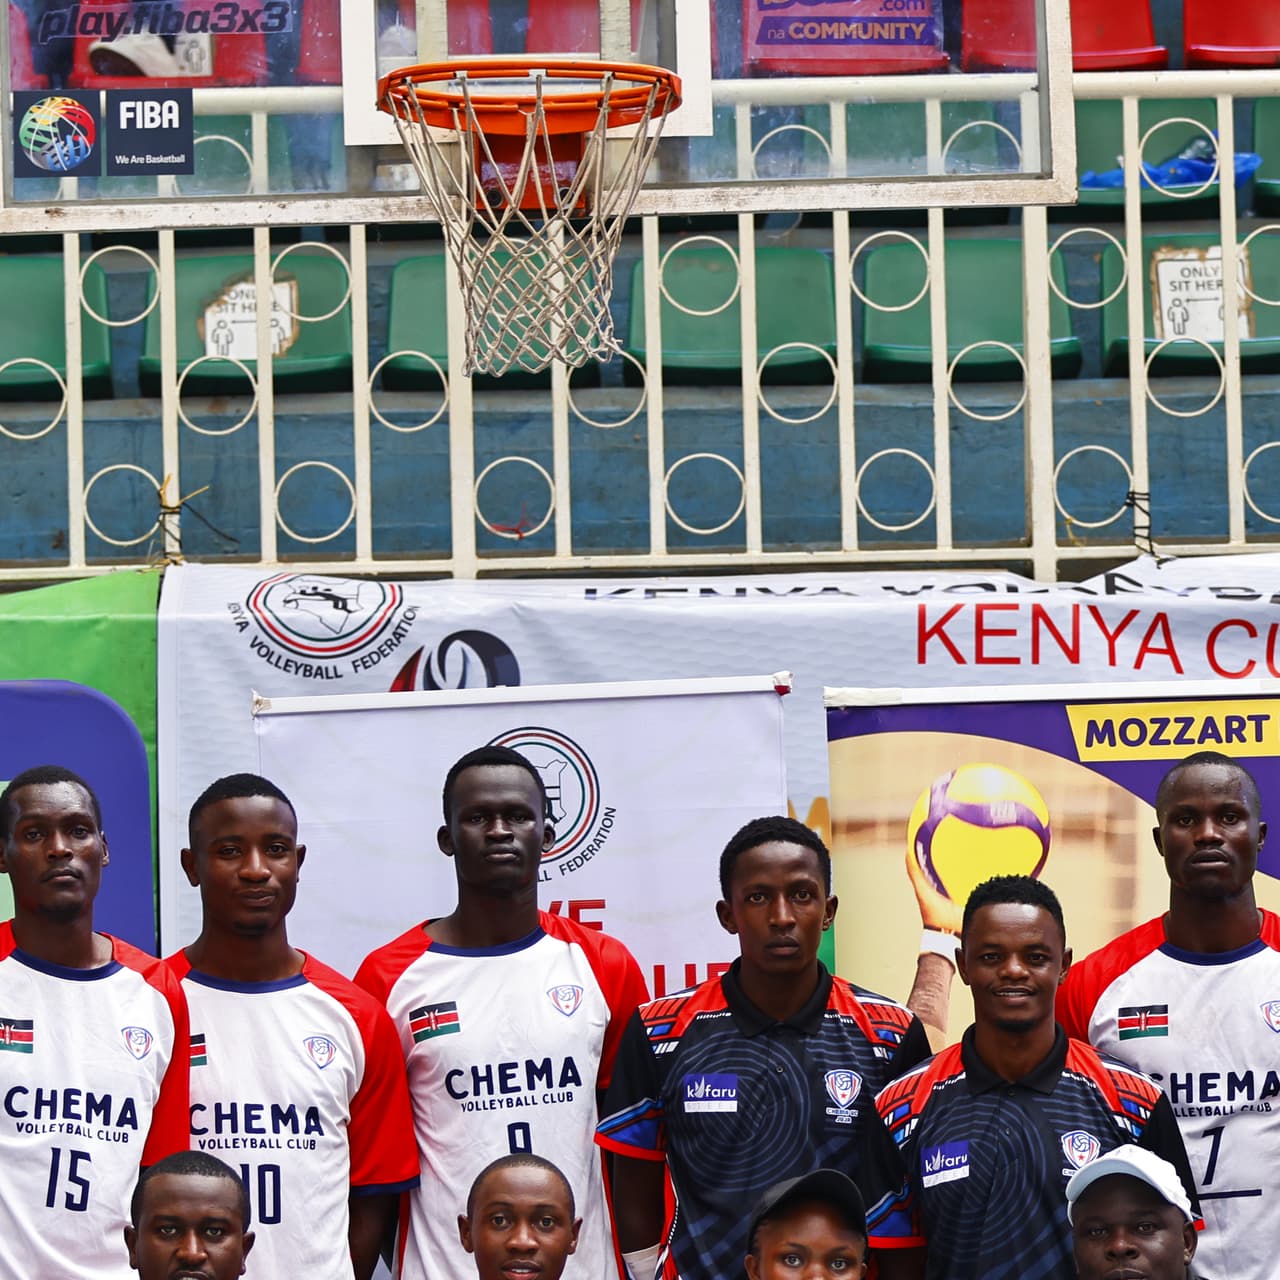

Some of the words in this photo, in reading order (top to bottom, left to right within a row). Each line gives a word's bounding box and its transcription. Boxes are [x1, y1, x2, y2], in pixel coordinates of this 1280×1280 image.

[767, 28, 786, 40] na
[788, 22, 927, 41] COMMUNITY
[119, 100, 180, 129] FIBA
[115, 155, 129, 165] We
[130, 155, 145, 165] Are
[146, 154, 186, 165] Basketball
[1170, 280, 1191, 291] SIT
[1196, 280, 1224, 291] HER
[1180, 266, 1220, 279] ONLY
[249, 635, 344, 680] VOLLEYBALL
[351, 604, 420, 674] FEDERATION
[917, 603, 1185, 675] KENYA
[1083, 713, 1273, 749] MOZZART
[558, 806, 617, 876] FEDERATION
[445, 1056, 582, 1100] CHEMA
[4, 1085, 139, 1131] CHEMA
[461, 1094, 539, 1112] VOLLEYBALL
[541, 1090, 574, 1106] CLUB
[1174, 1105, 1236, 1118] LLEYBALL
[16, 1121, 93, 1140] VOLLEYBALL
[96, 1129, 129, 1144] CLUB
[190, 1102, 326, 1137] CHEMA
[198, 1138, 283, 1151] VOLLEYBALL
[286, 1138, 317, 1151] CLUB
[45, 1146, 92, 1212] 15
[240, 1163, 282, 1225] 10
